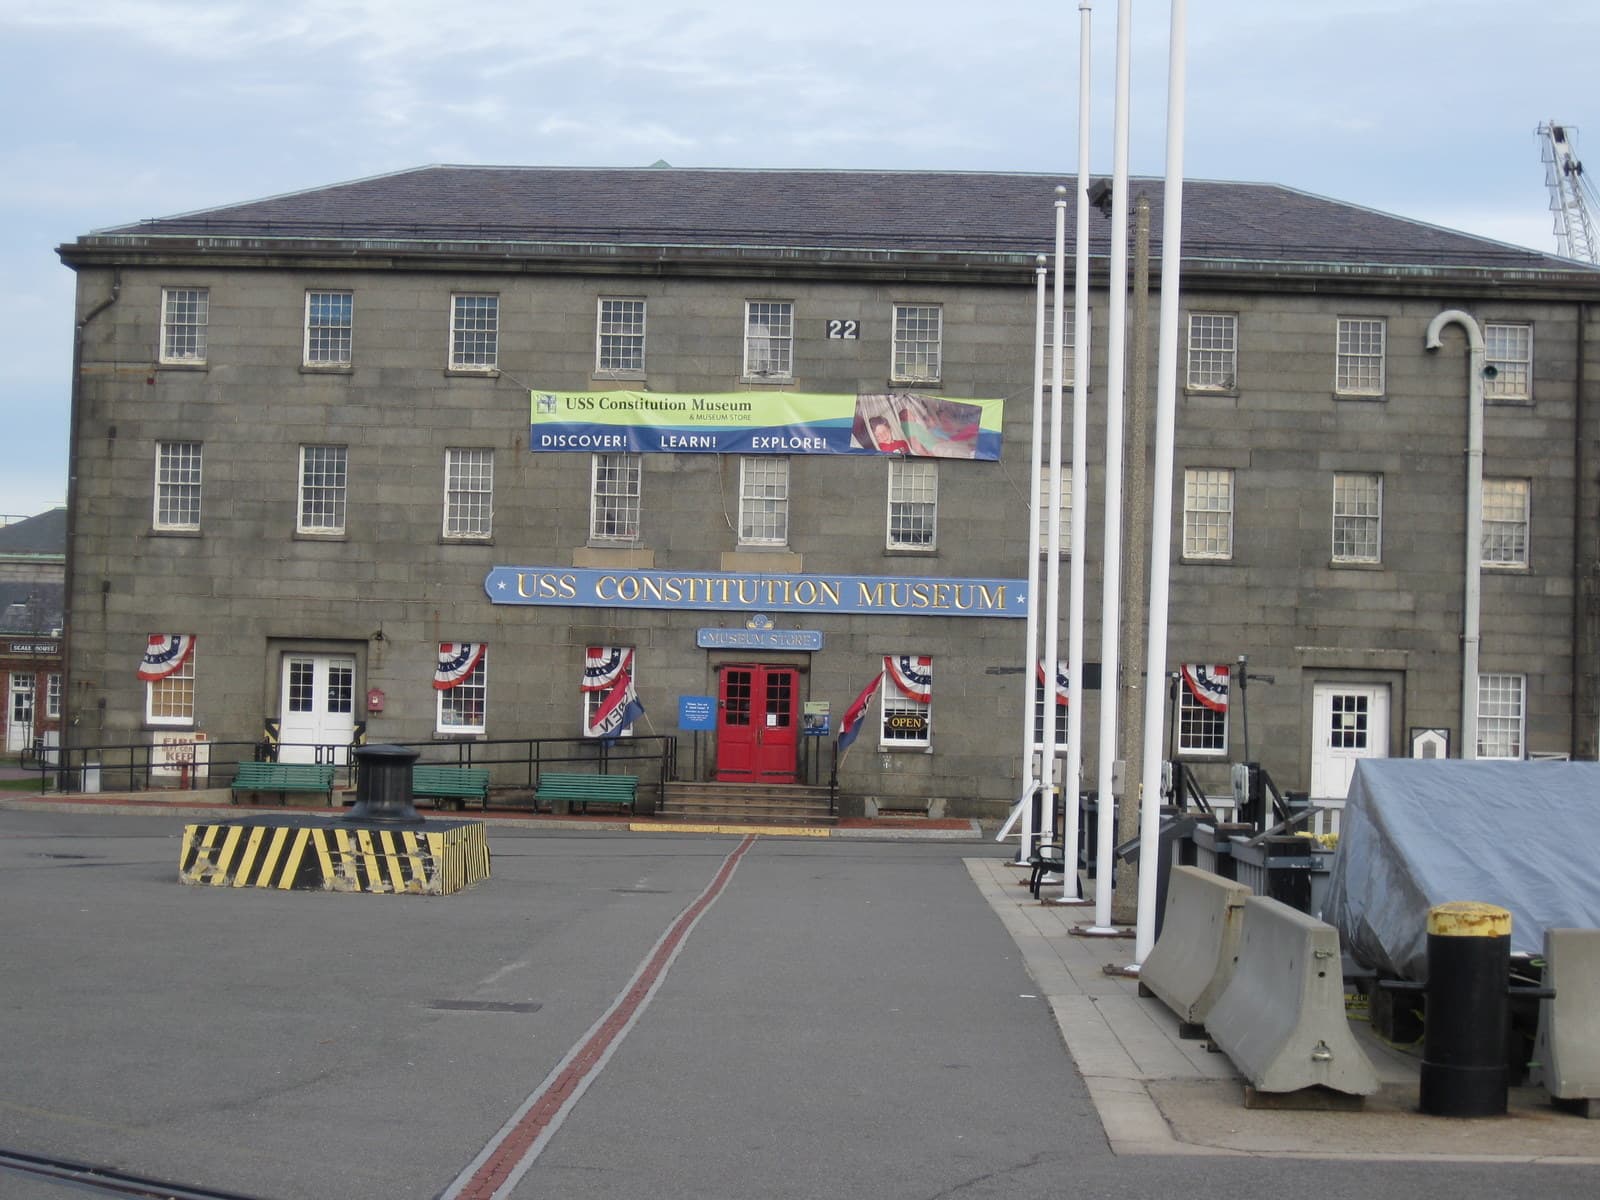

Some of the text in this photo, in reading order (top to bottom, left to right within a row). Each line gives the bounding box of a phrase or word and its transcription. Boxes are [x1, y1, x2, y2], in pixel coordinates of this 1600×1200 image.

[829, 319, 857, 339] 22
[566, 396, 752, 411] USS Constitution Museum
[696, 413, 728, 421] MUSEUM
[541, 434, 827, 449] DISCOVER! LEARN! EXPLORE!
[516, 573, 1008, 610] USS CONSTITUTION MUSEUM
[707, 632, 811, 646] MUSEUM STORE
[891, 717, 922, 728] OPEN
[165, 751, 193, 761] KEEP
